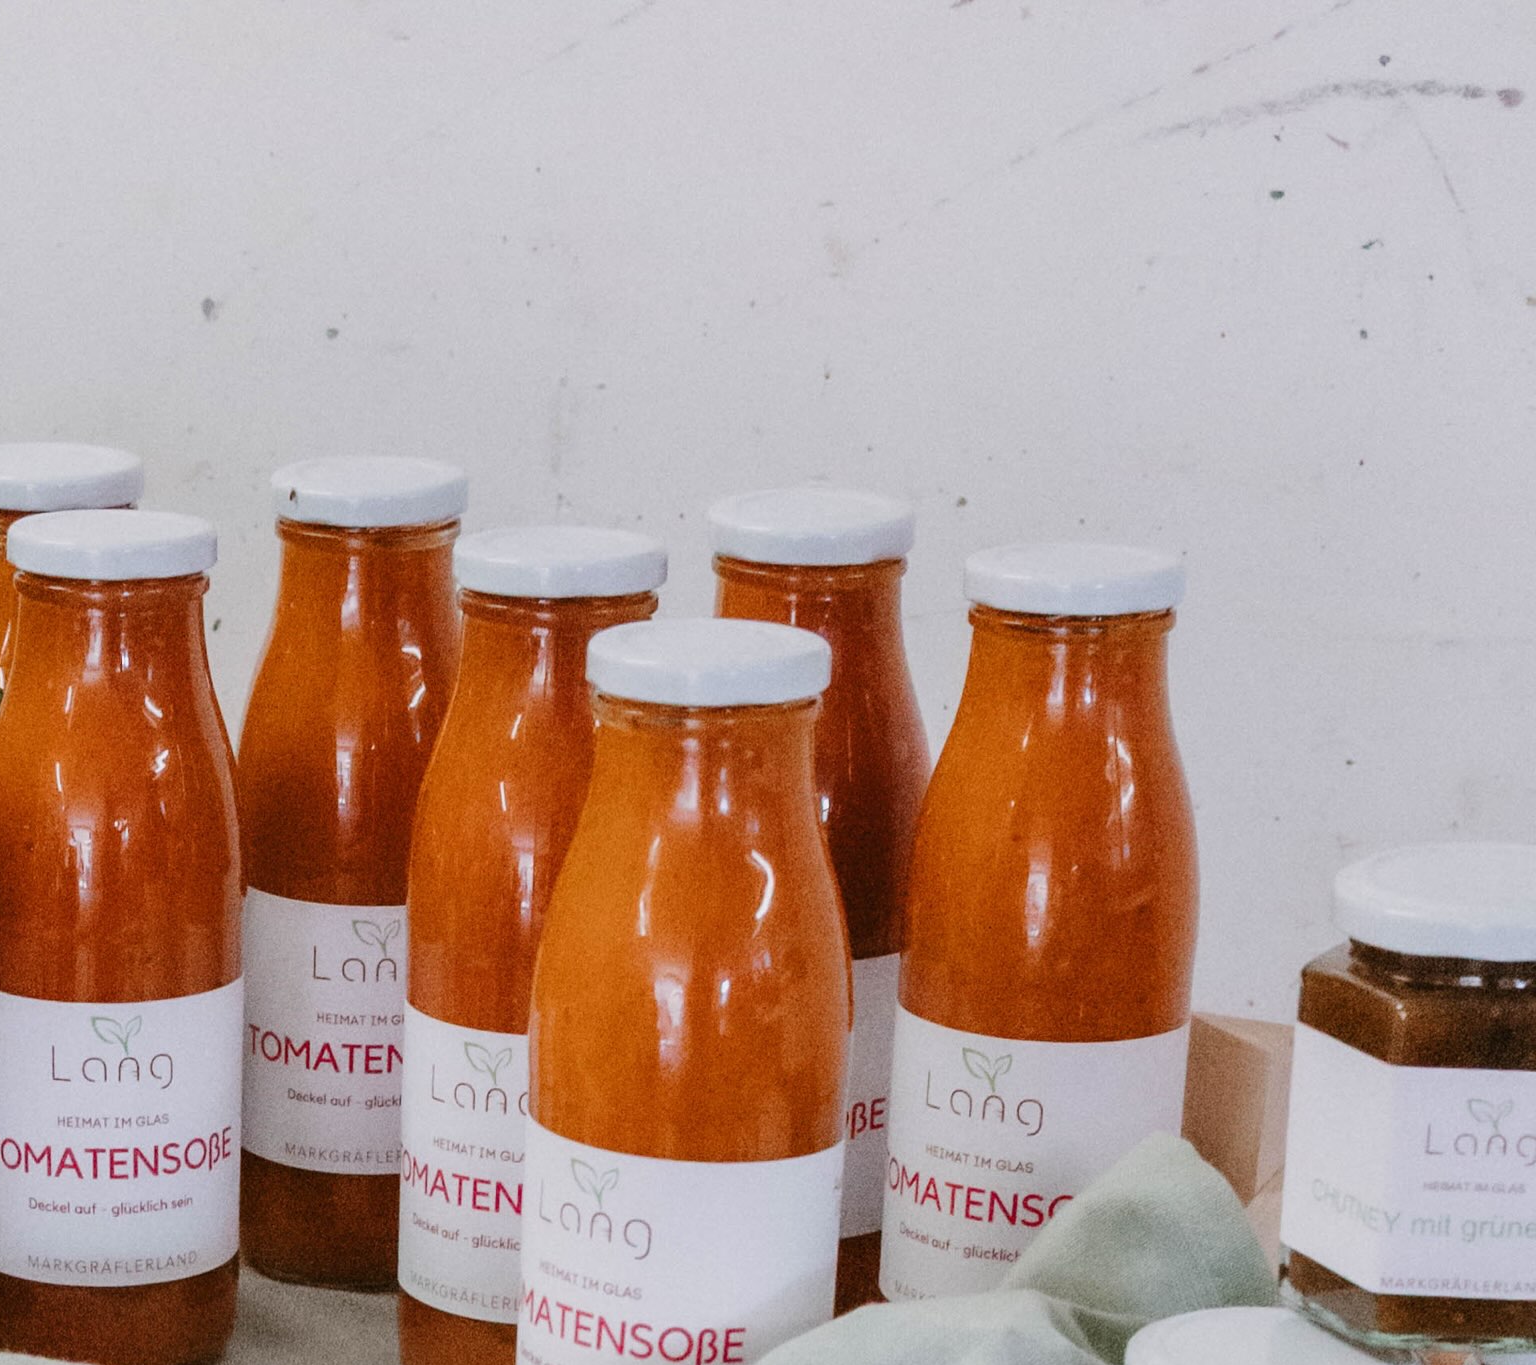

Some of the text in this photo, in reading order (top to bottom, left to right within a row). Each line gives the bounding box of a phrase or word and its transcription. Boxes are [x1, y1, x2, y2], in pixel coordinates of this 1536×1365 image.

[316, 1012, 365, 1025] HEIMAT
[371, 1014, 388, 1025] IM
[52, 1045, 173, 1089] Lang
[287, 1088, 327, 1106] Deckel
[330, 1095, 352, 1107] auf
[926, 1070, 1044, 1136] Lang
[57, 1113, 170, 1129] HEIMAT IM GLAS
[846, 1098, 886, 1139] ßE
[433, 1136, 476, 1156] HEIMAT
[479, 1148, 496, 1159] IM
[925, 1144, 1034, 1174] HEIMAT IM GLAS
[401, 1146, 524, 1216] OMATEN
[1423, 1181, 1527, 1194] HEIMAT IM GLAS
[28, 1197, 71, 1214] Deckel
[75, 1203, 96, 1215] auf
[111, 1199, 168, 1217] glücklich
[172, 1195, 194, 1209] sein
[539, 1178, 652, 1260] Lang
[413, 1213, 439, 1235] Deckel
[441, 1229, 460, 1241] auf
[900, 1221, 929, 1244] Deckel
[932, 1238, 950, 1251] auf
[1411, 1214, 1452, 1237] mit
[540, 1261, 643, 1300] HEIMAT IM GLAS
